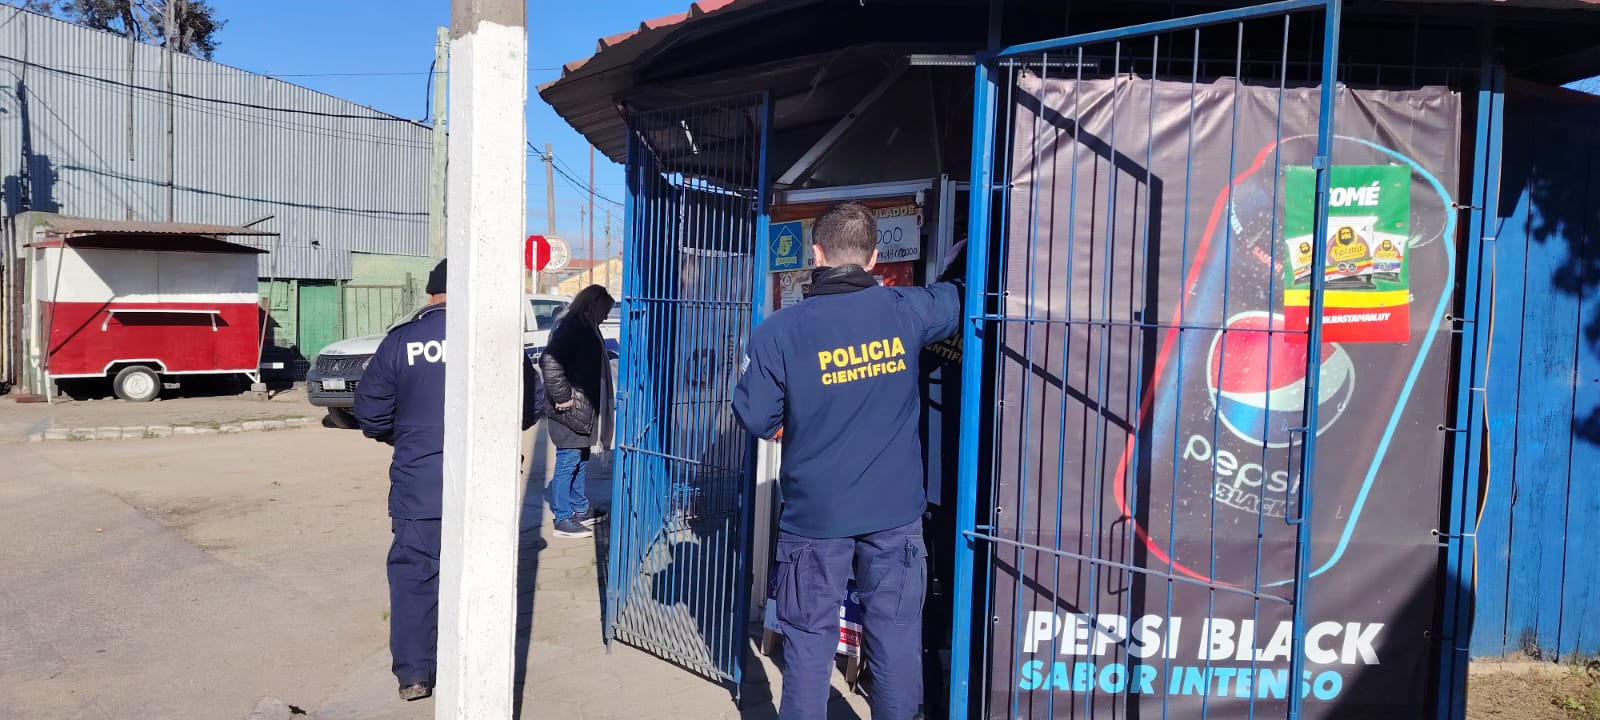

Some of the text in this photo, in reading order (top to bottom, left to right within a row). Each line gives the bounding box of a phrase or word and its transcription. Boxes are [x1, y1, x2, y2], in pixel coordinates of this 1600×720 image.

[818, 337, 905, 370] POLICIA
[822, 359, 906, 385] CIENTÍFICA
[1183, 435, 1300, 493] pepsi
[1023, 611, 1384, 665] PEPSI BLACK
[1019, 660, 1342, 701] SABOR INTENSO
